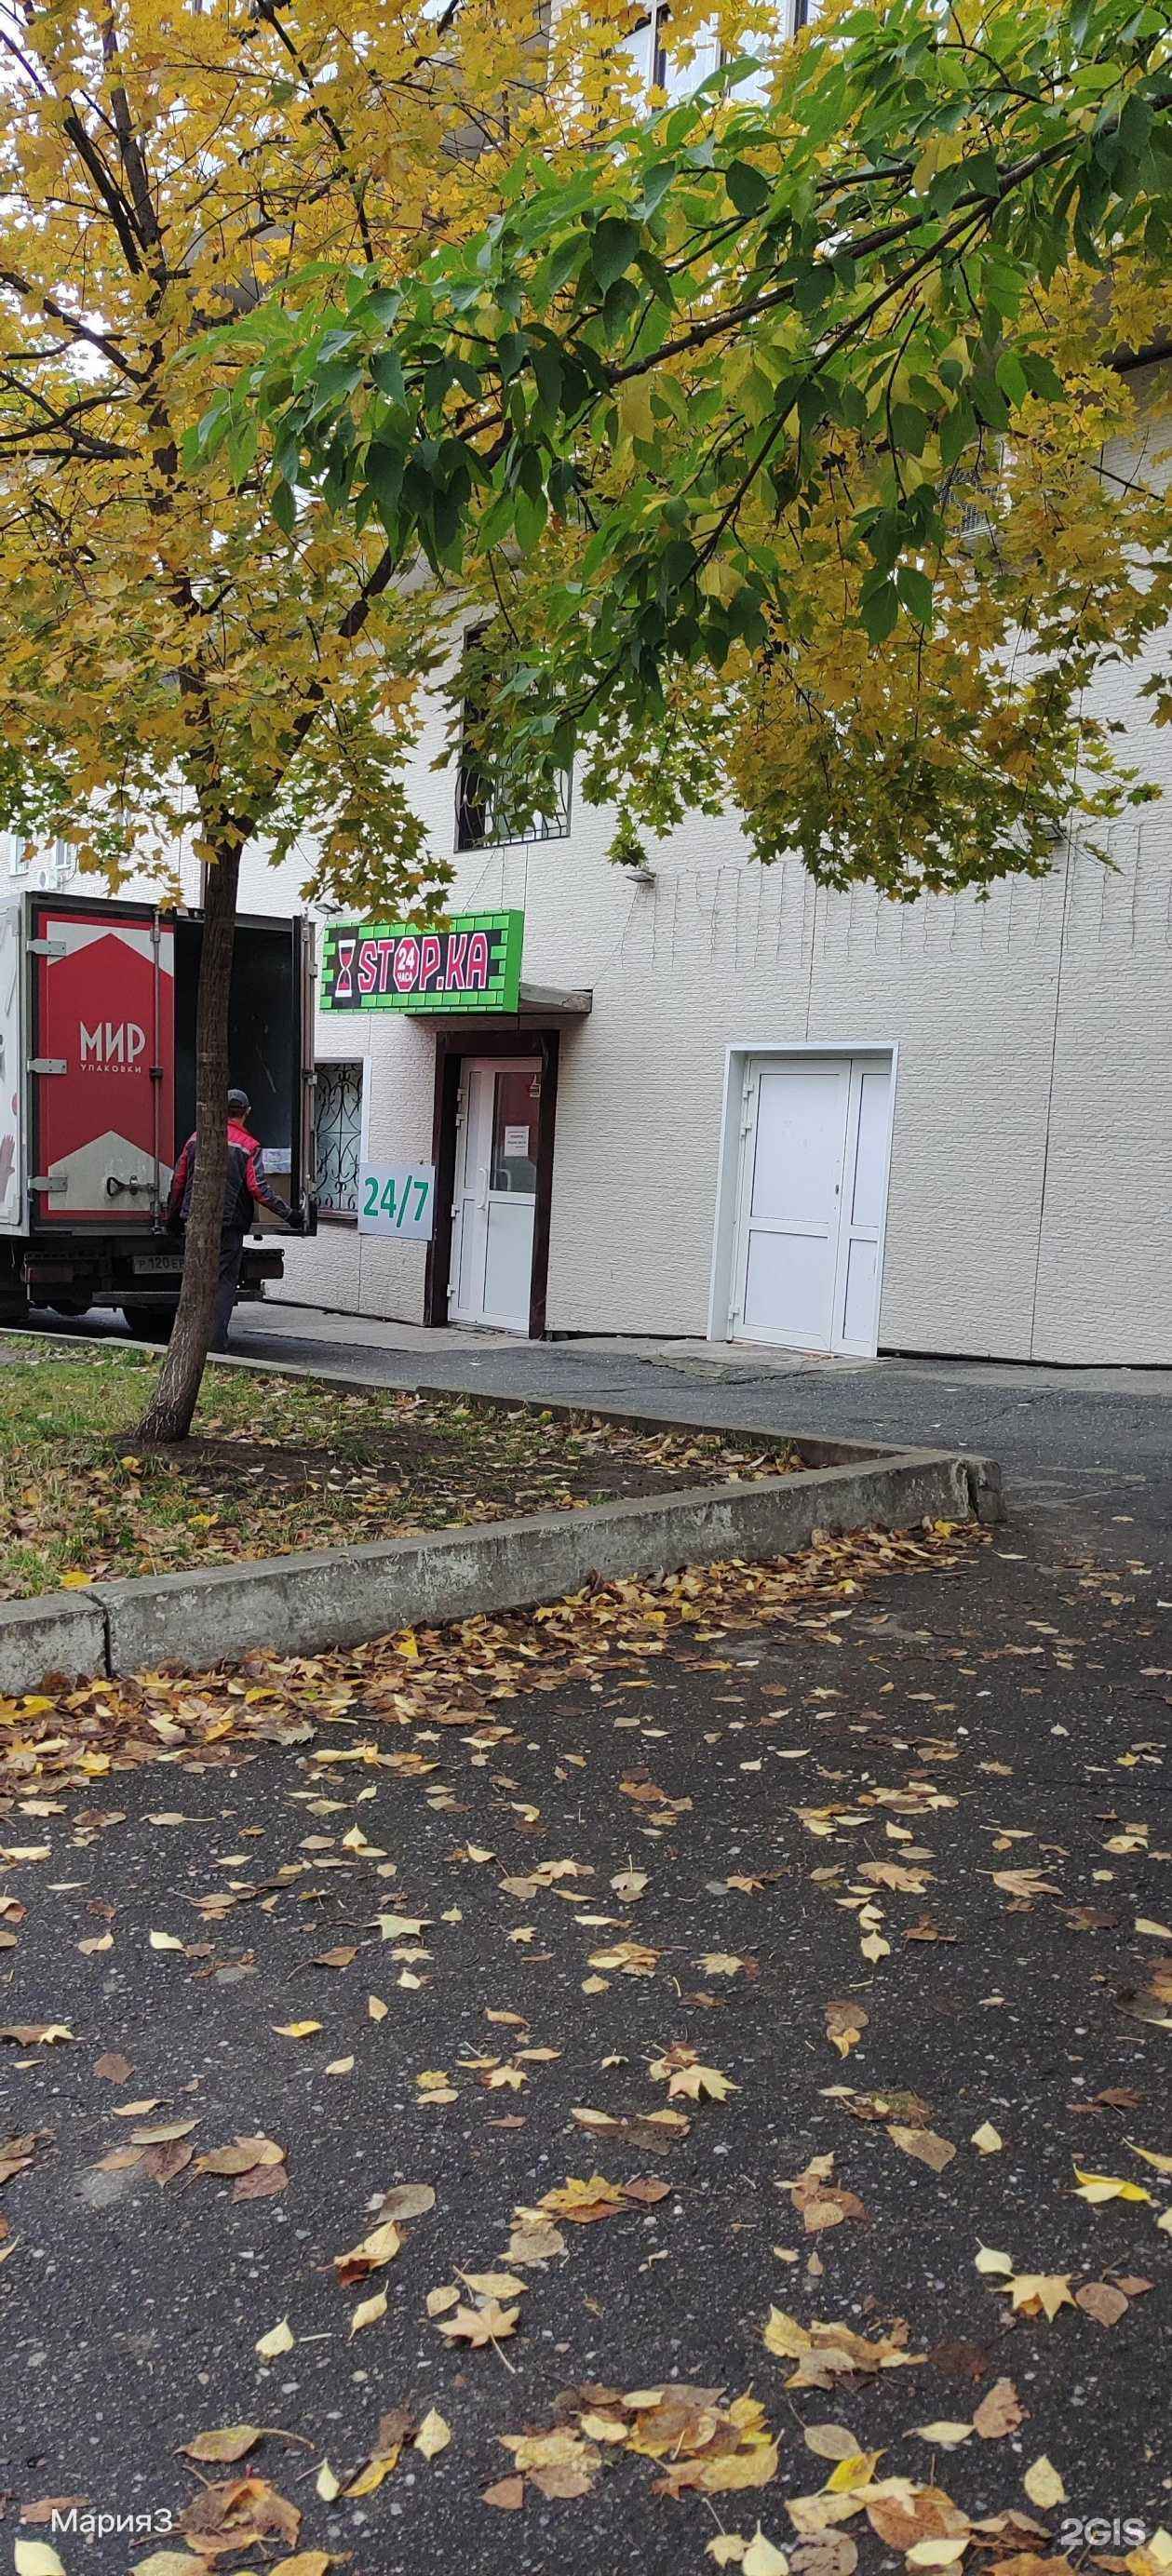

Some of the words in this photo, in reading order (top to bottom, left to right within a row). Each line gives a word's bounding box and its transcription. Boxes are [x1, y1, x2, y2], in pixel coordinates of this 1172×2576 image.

[357, 932, 489, 993] STOP.KA
[397, 946, 415, 970] 24
[397, 972, 413, 983] ЧАСА
[80, 1021, 146, 1063] МИР
[80, 1064, 141, 1074] УПАКОВКИ
[363, 1174, 429, 1228] 24/7
